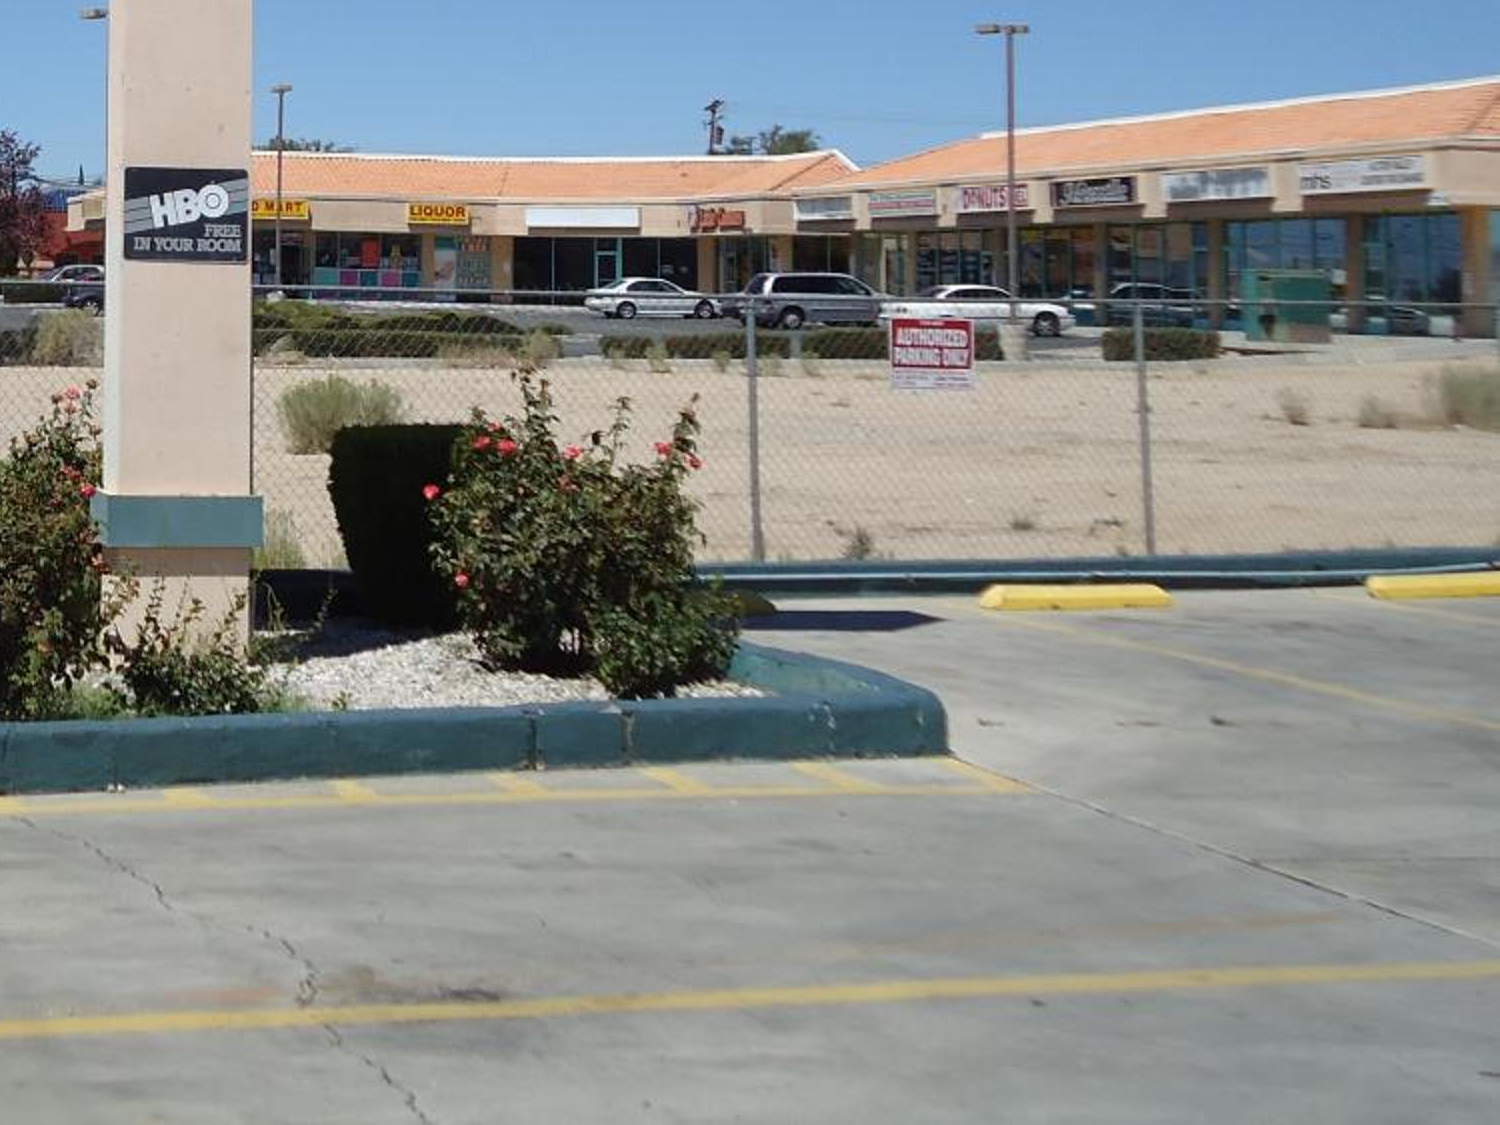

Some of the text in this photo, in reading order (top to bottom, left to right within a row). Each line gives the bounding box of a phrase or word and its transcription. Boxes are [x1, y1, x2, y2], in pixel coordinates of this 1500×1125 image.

[149, 184, 229, 228] HBO
[265, 201, 302, 212] MART
[410, 205, 466, 217] LIQUOR
[204, 225, 241, 237] FREE
[134, 237, 241, 252] IN YOUR ROOM
